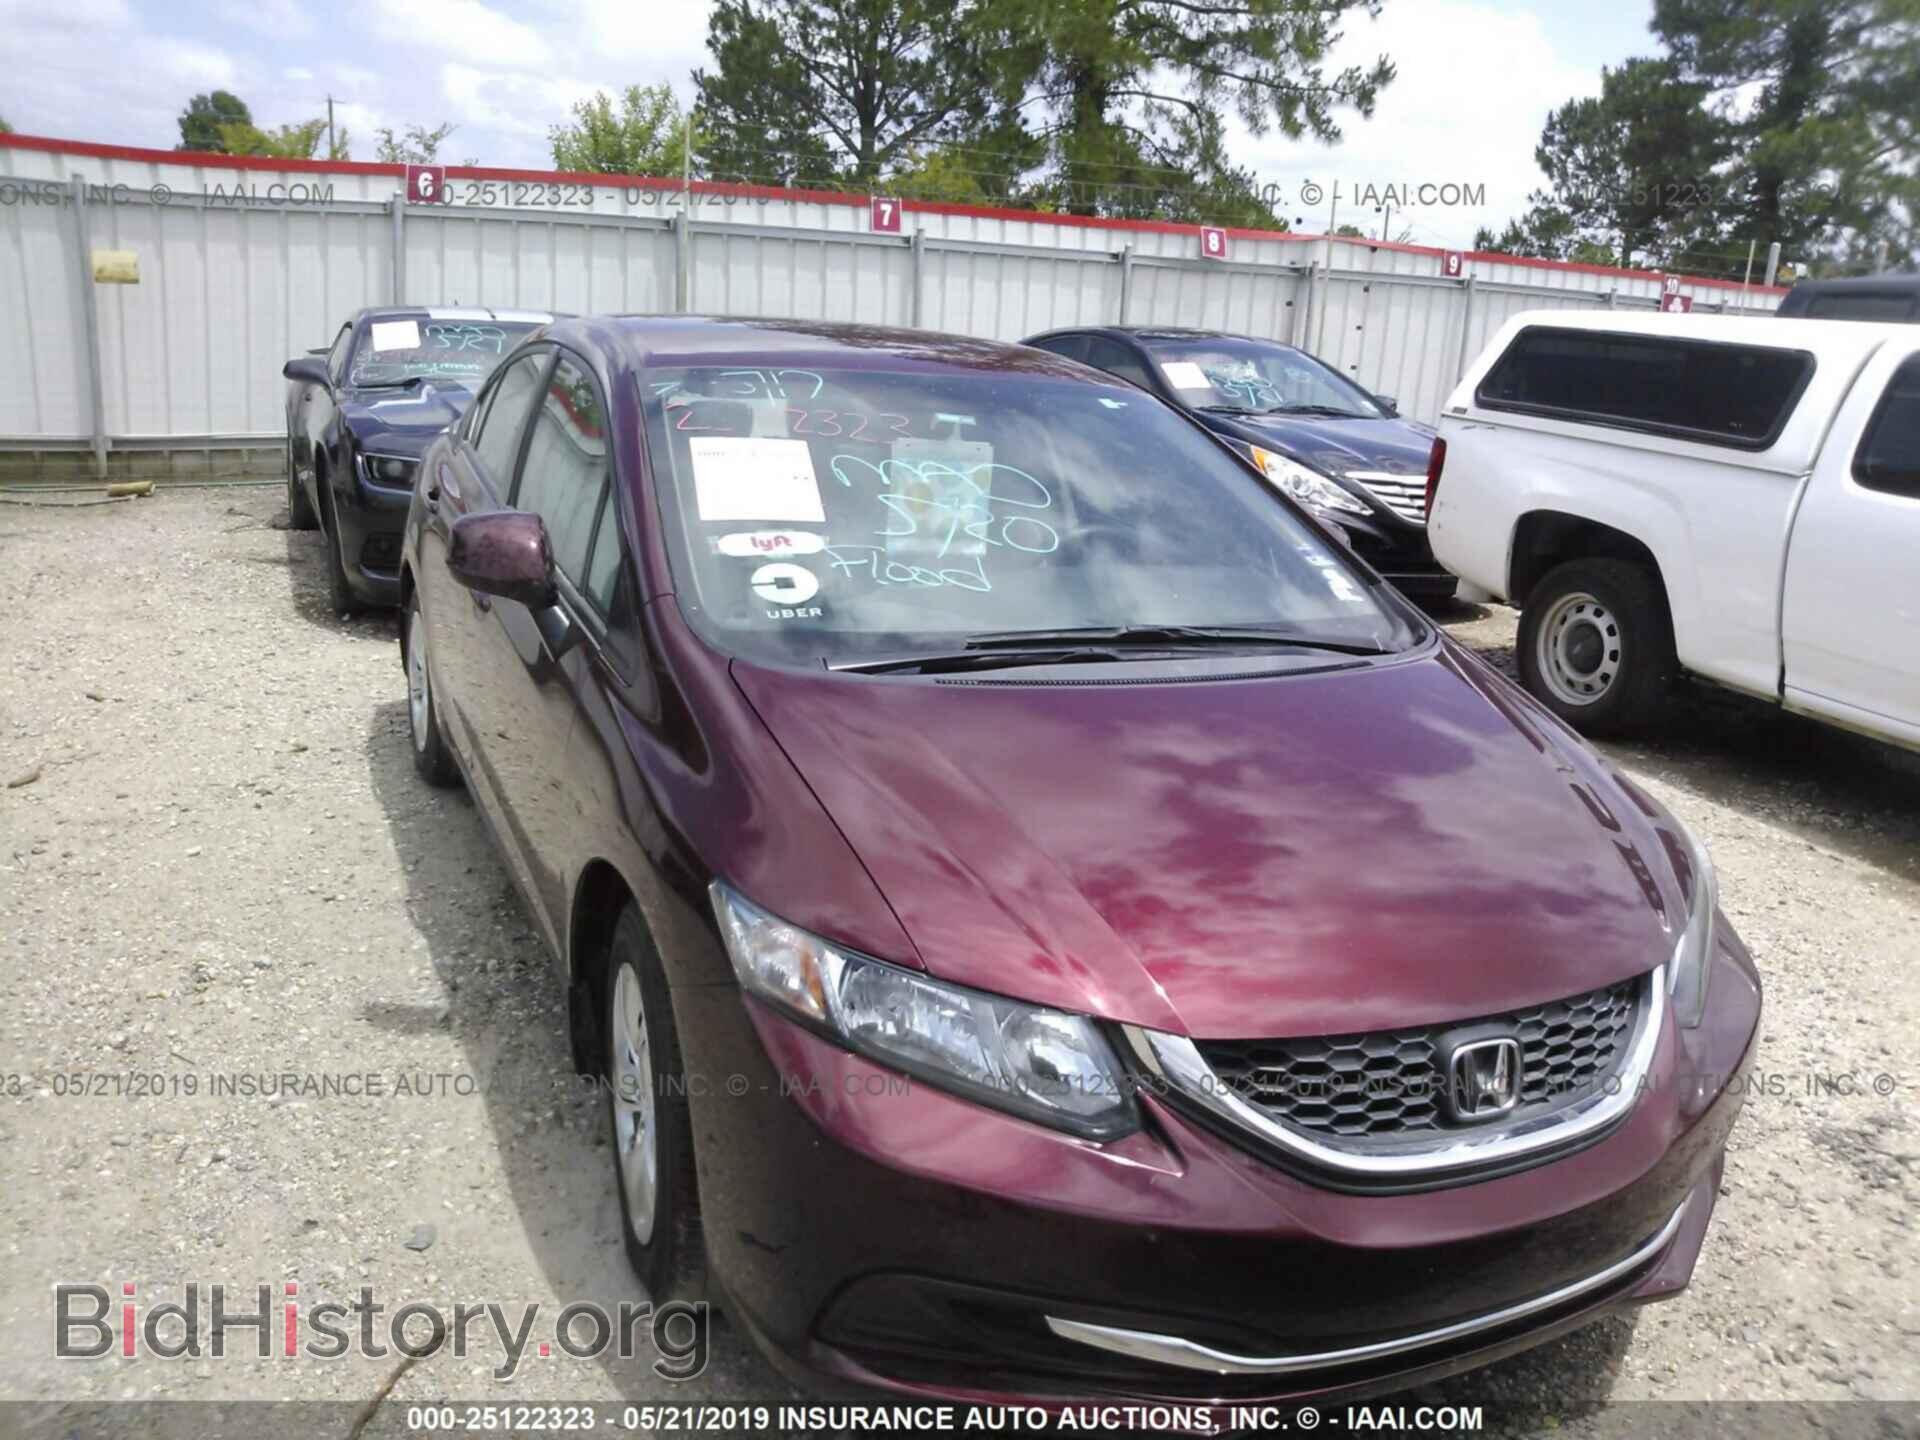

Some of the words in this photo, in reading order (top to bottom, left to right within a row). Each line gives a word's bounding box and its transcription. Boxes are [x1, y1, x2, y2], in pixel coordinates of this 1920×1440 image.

[417, 171, 434, 198] 6
[880, 203, 893, 227] 7
[1207, 232, 1221, 252] 8
[1448, 257, 1459, 273] 9
[766, 606, 824, 620] UBER
